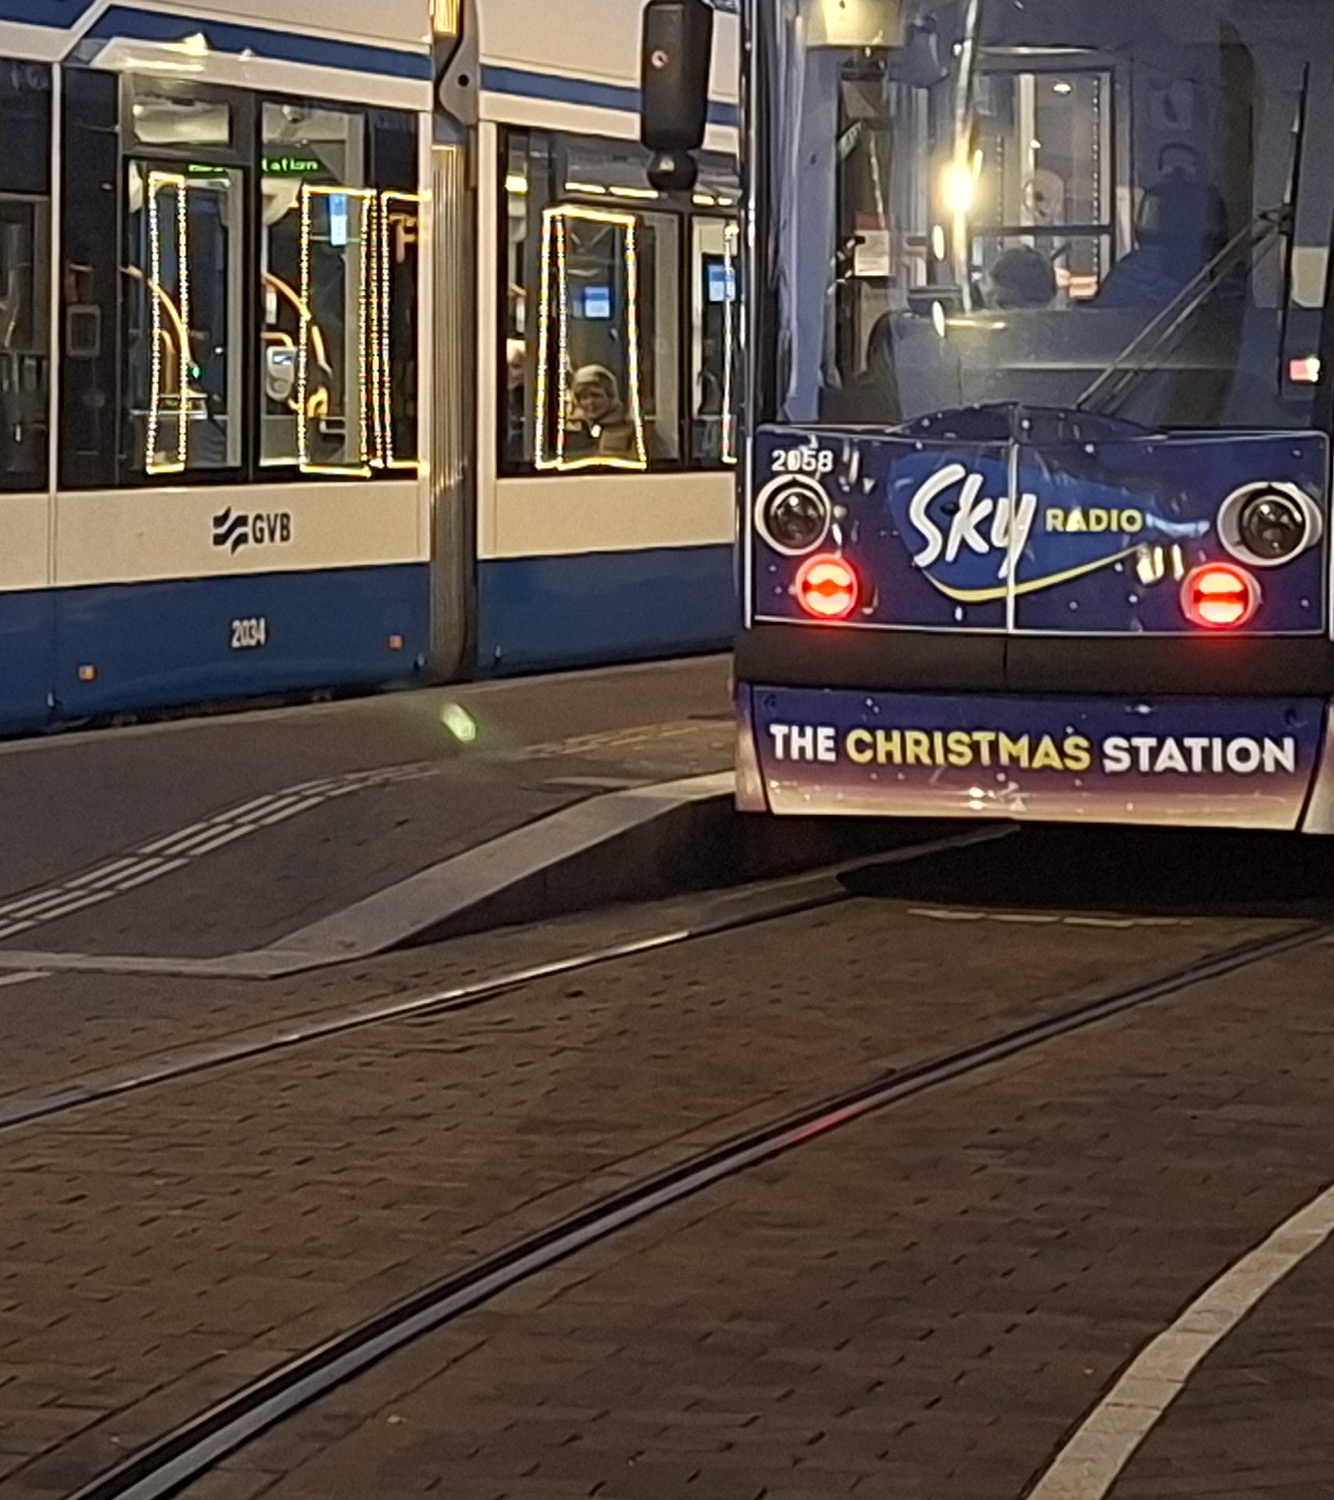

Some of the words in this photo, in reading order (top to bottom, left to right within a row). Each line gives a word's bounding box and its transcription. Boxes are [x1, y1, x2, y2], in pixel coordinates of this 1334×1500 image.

[770, 449, 834, 473] 2058
[252, 513, 291, 544] GVB
[909, 463, 1038, 580] Sky
[1045, 507, 1144, 533] RADIO
[231, 618, 266, 647] 2034
[769, 723, 837, 762] THE
[845, 728, 1092, 772] CHRISTMAS
[1102, 735, 1296, 775] STATION
